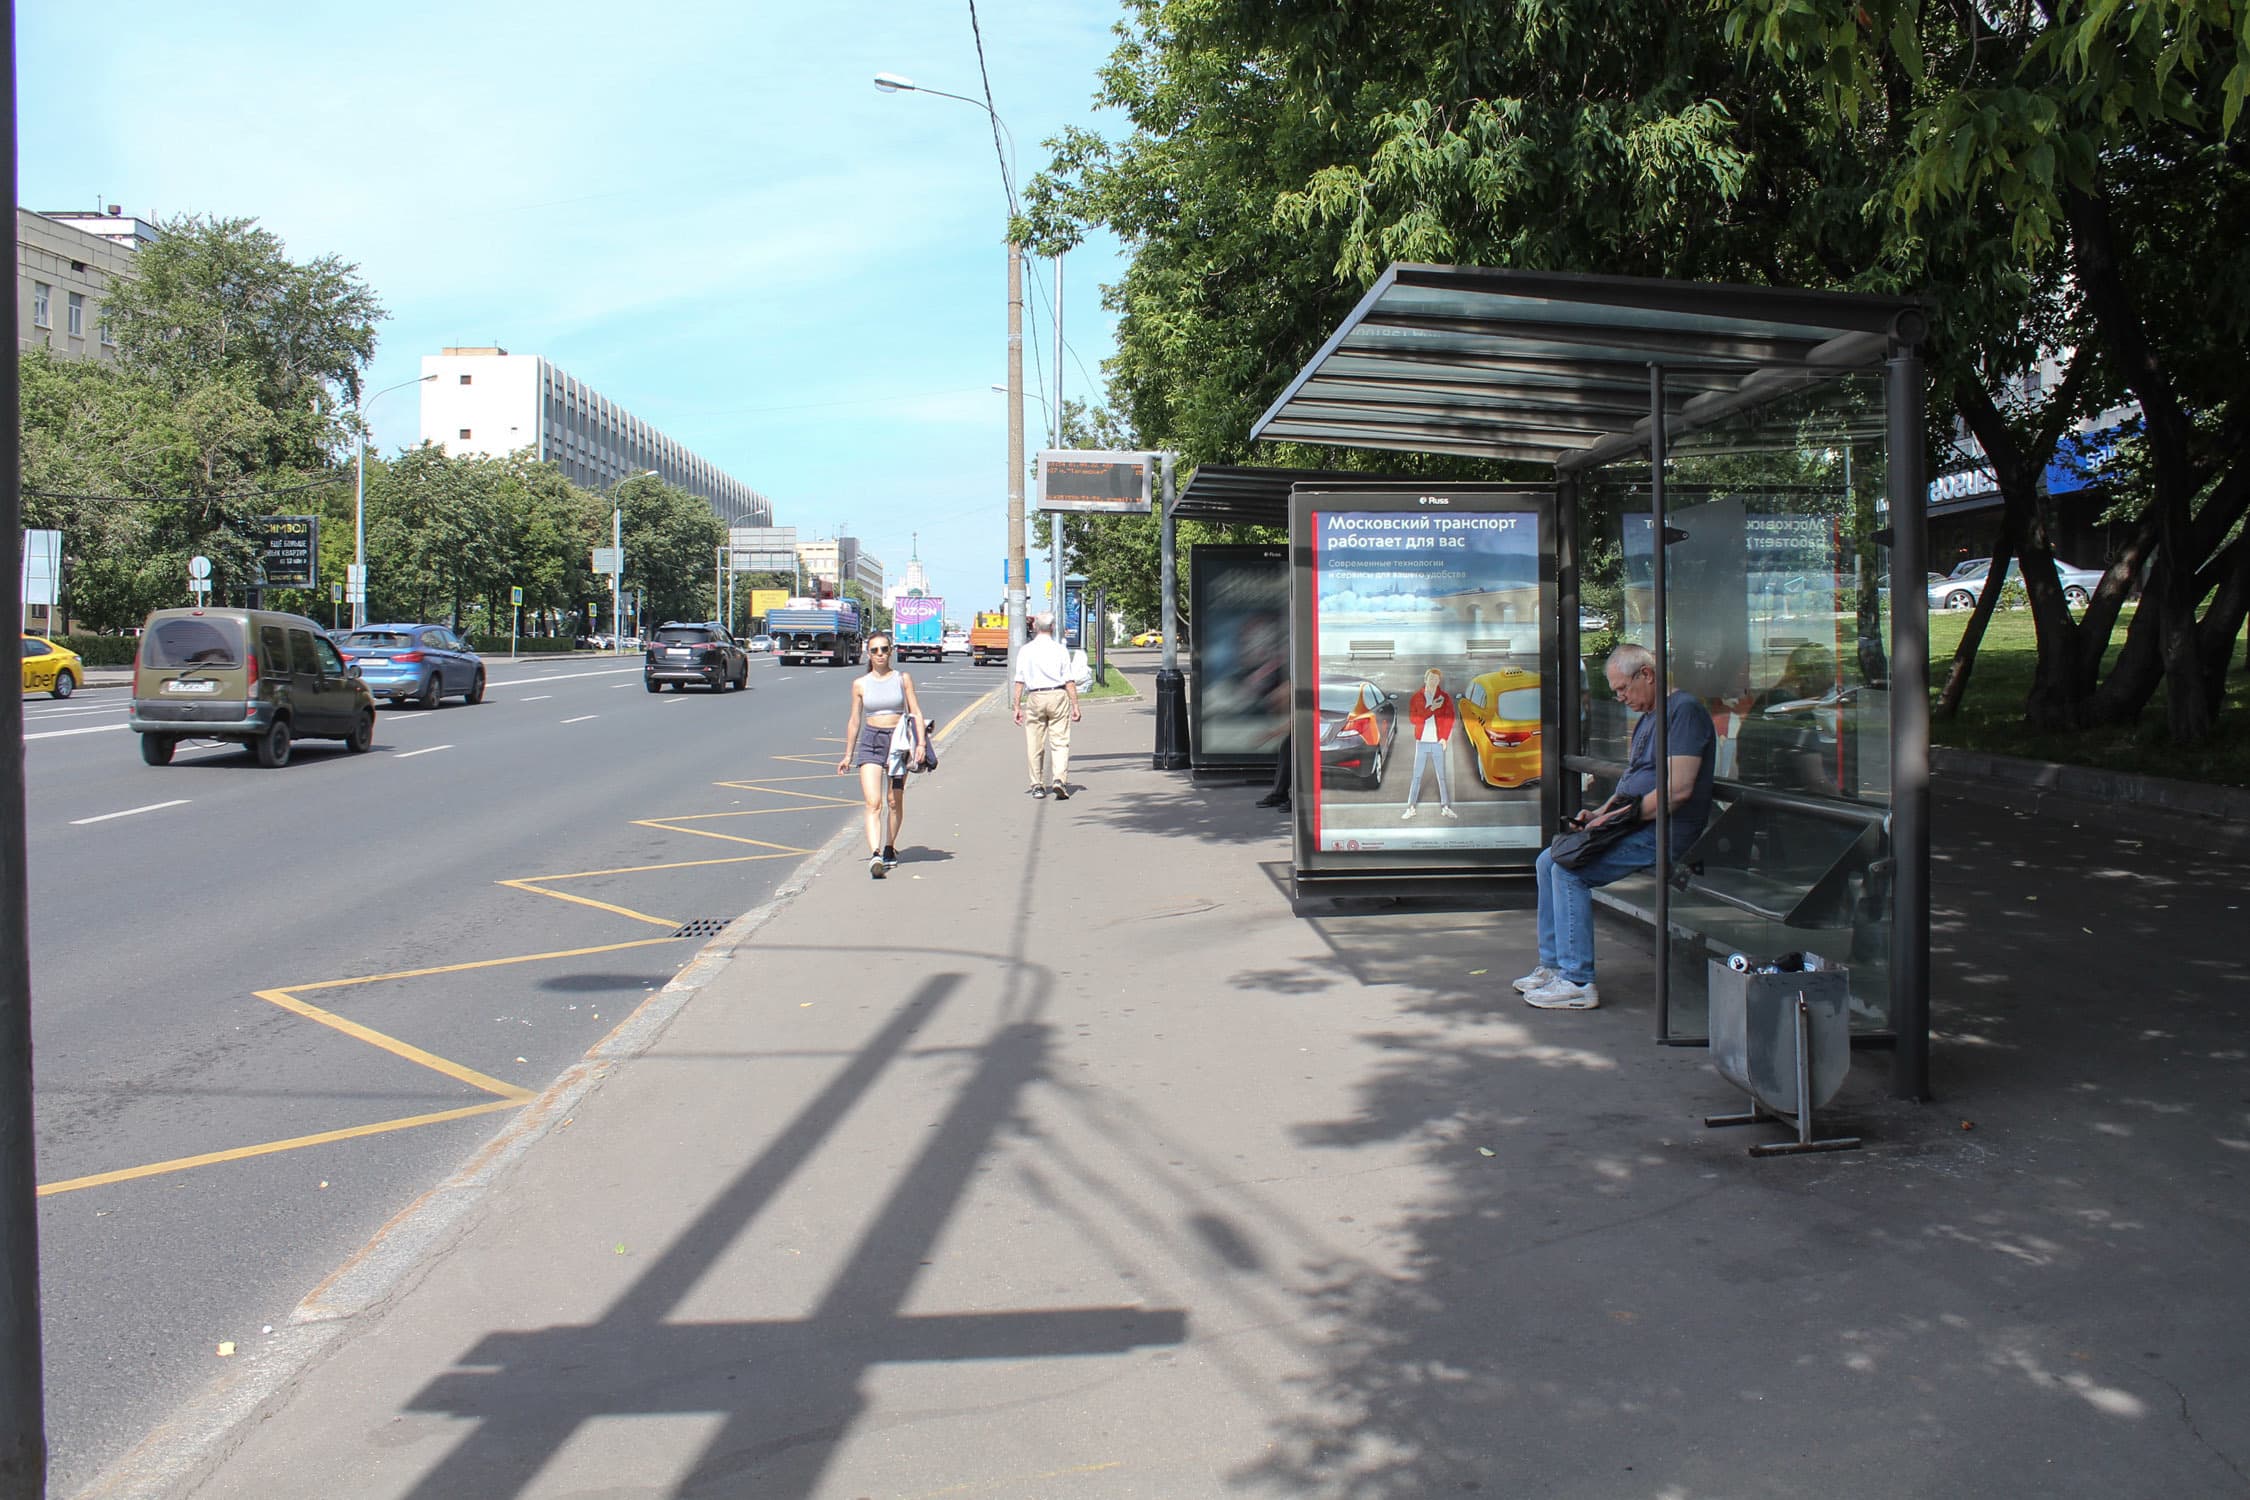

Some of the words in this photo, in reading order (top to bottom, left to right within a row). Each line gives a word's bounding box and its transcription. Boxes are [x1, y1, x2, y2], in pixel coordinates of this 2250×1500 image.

[1428, 496, 1449, 505] Russ
[1328, 516, 1430, 530] Московский
[1434, 518, 1517, 532] транспорт
[1328, 534, 1401, 550] работает
[1405, 536, 1435, 549] для
[1439, 536, 1465, 547] вас
[1328, 559, 1391, 568] Современные
[1393, 560, 1444, 568] технологии
[1426, 570, 1466, 580] удобства
[901, 606, 937, 616] OZON
[24, 671, 56, 688] Uber
